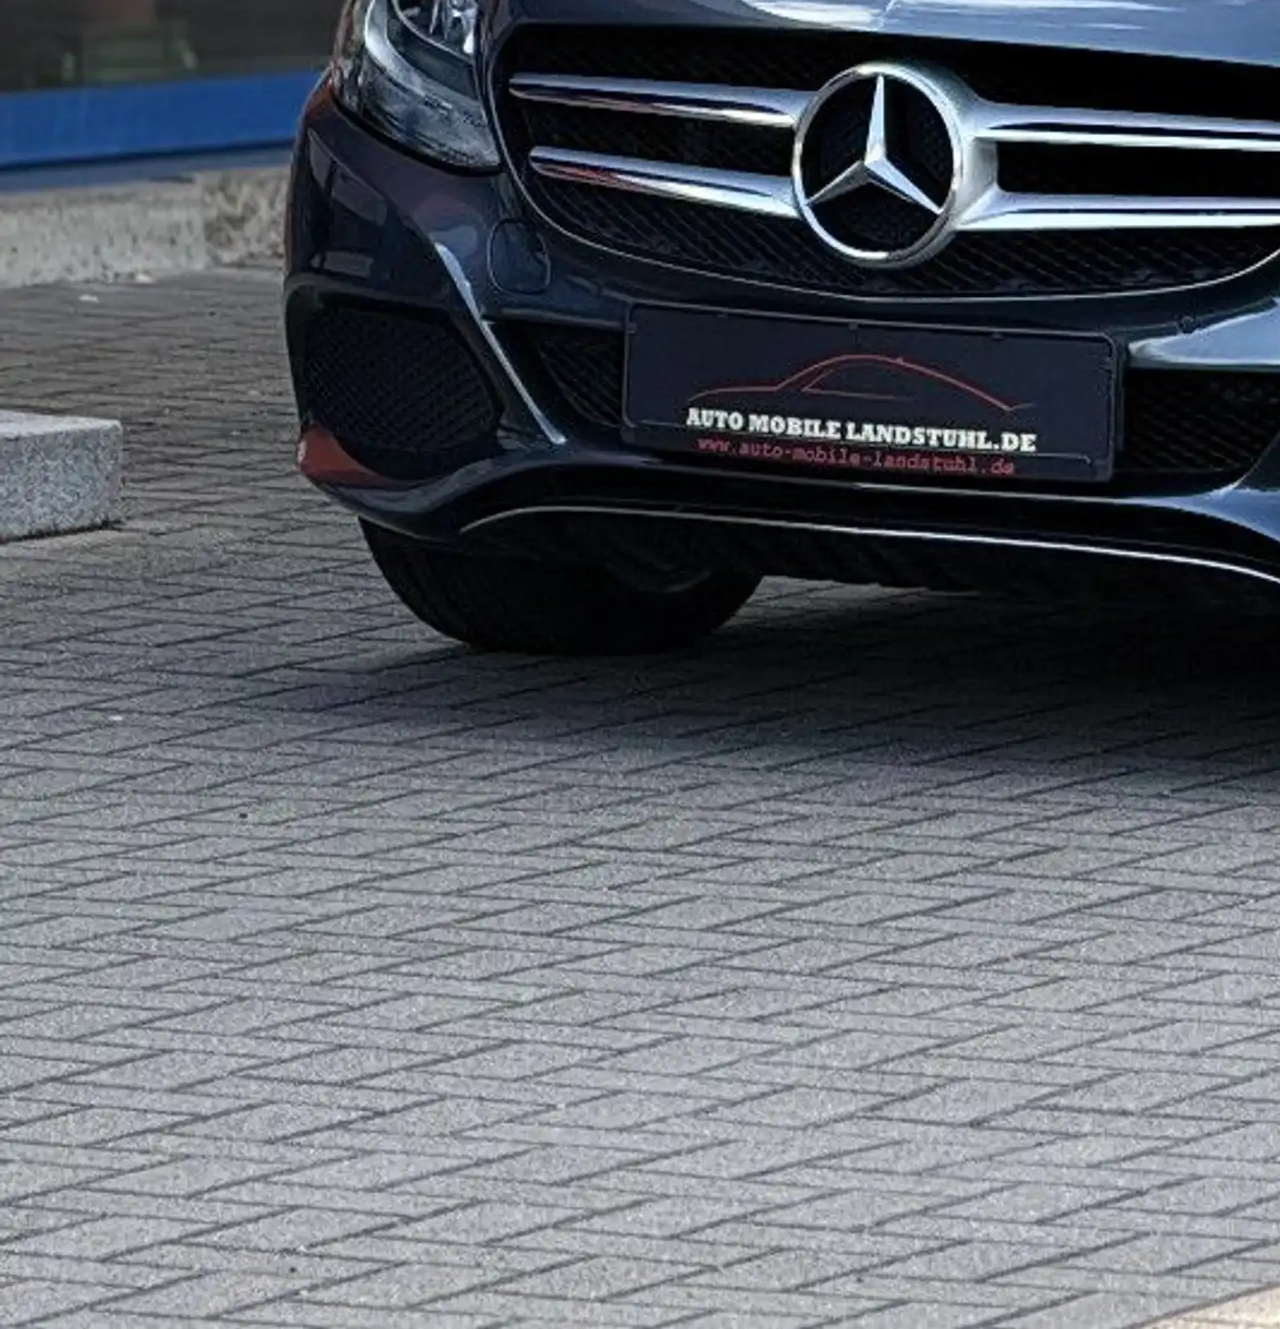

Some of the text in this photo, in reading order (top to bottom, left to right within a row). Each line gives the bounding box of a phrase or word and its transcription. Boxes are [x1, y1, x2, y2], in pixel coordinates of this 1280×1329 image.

[686, 407, 1037, 452] AUTO MOBILE LANDSTUHL.DE
[697, 438, 1015, 475] www.auto-mobile-landstuhl.de
